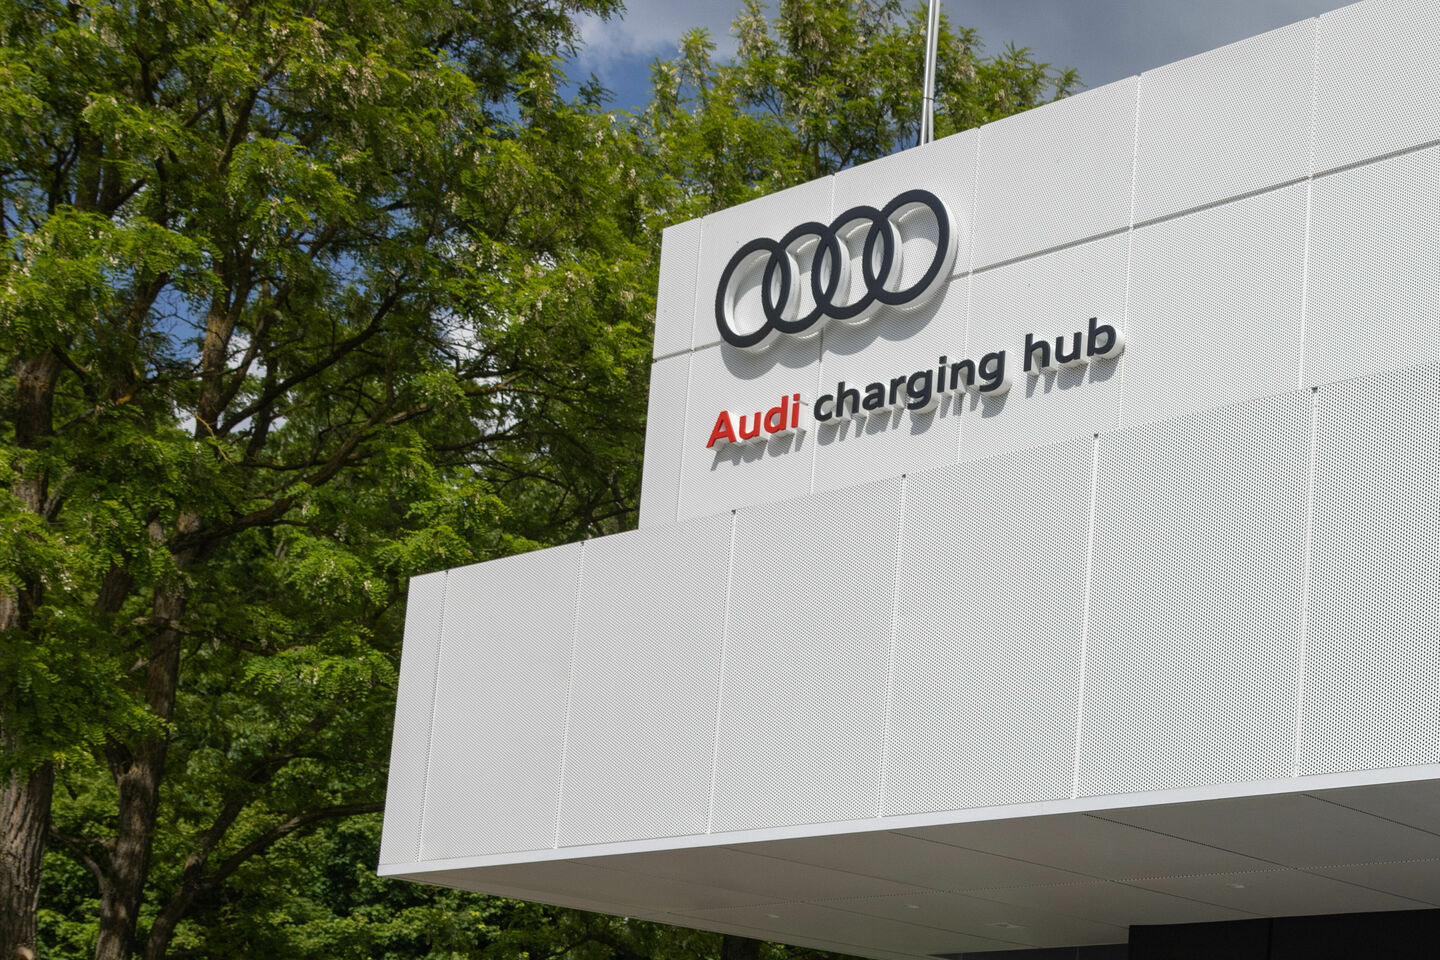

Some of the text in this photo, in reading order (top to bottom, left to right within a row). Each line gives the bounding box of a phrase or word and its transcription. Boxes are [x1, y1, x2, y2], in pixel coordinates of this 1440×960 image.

[706, 317, 1118, 449] Audi charging hub
